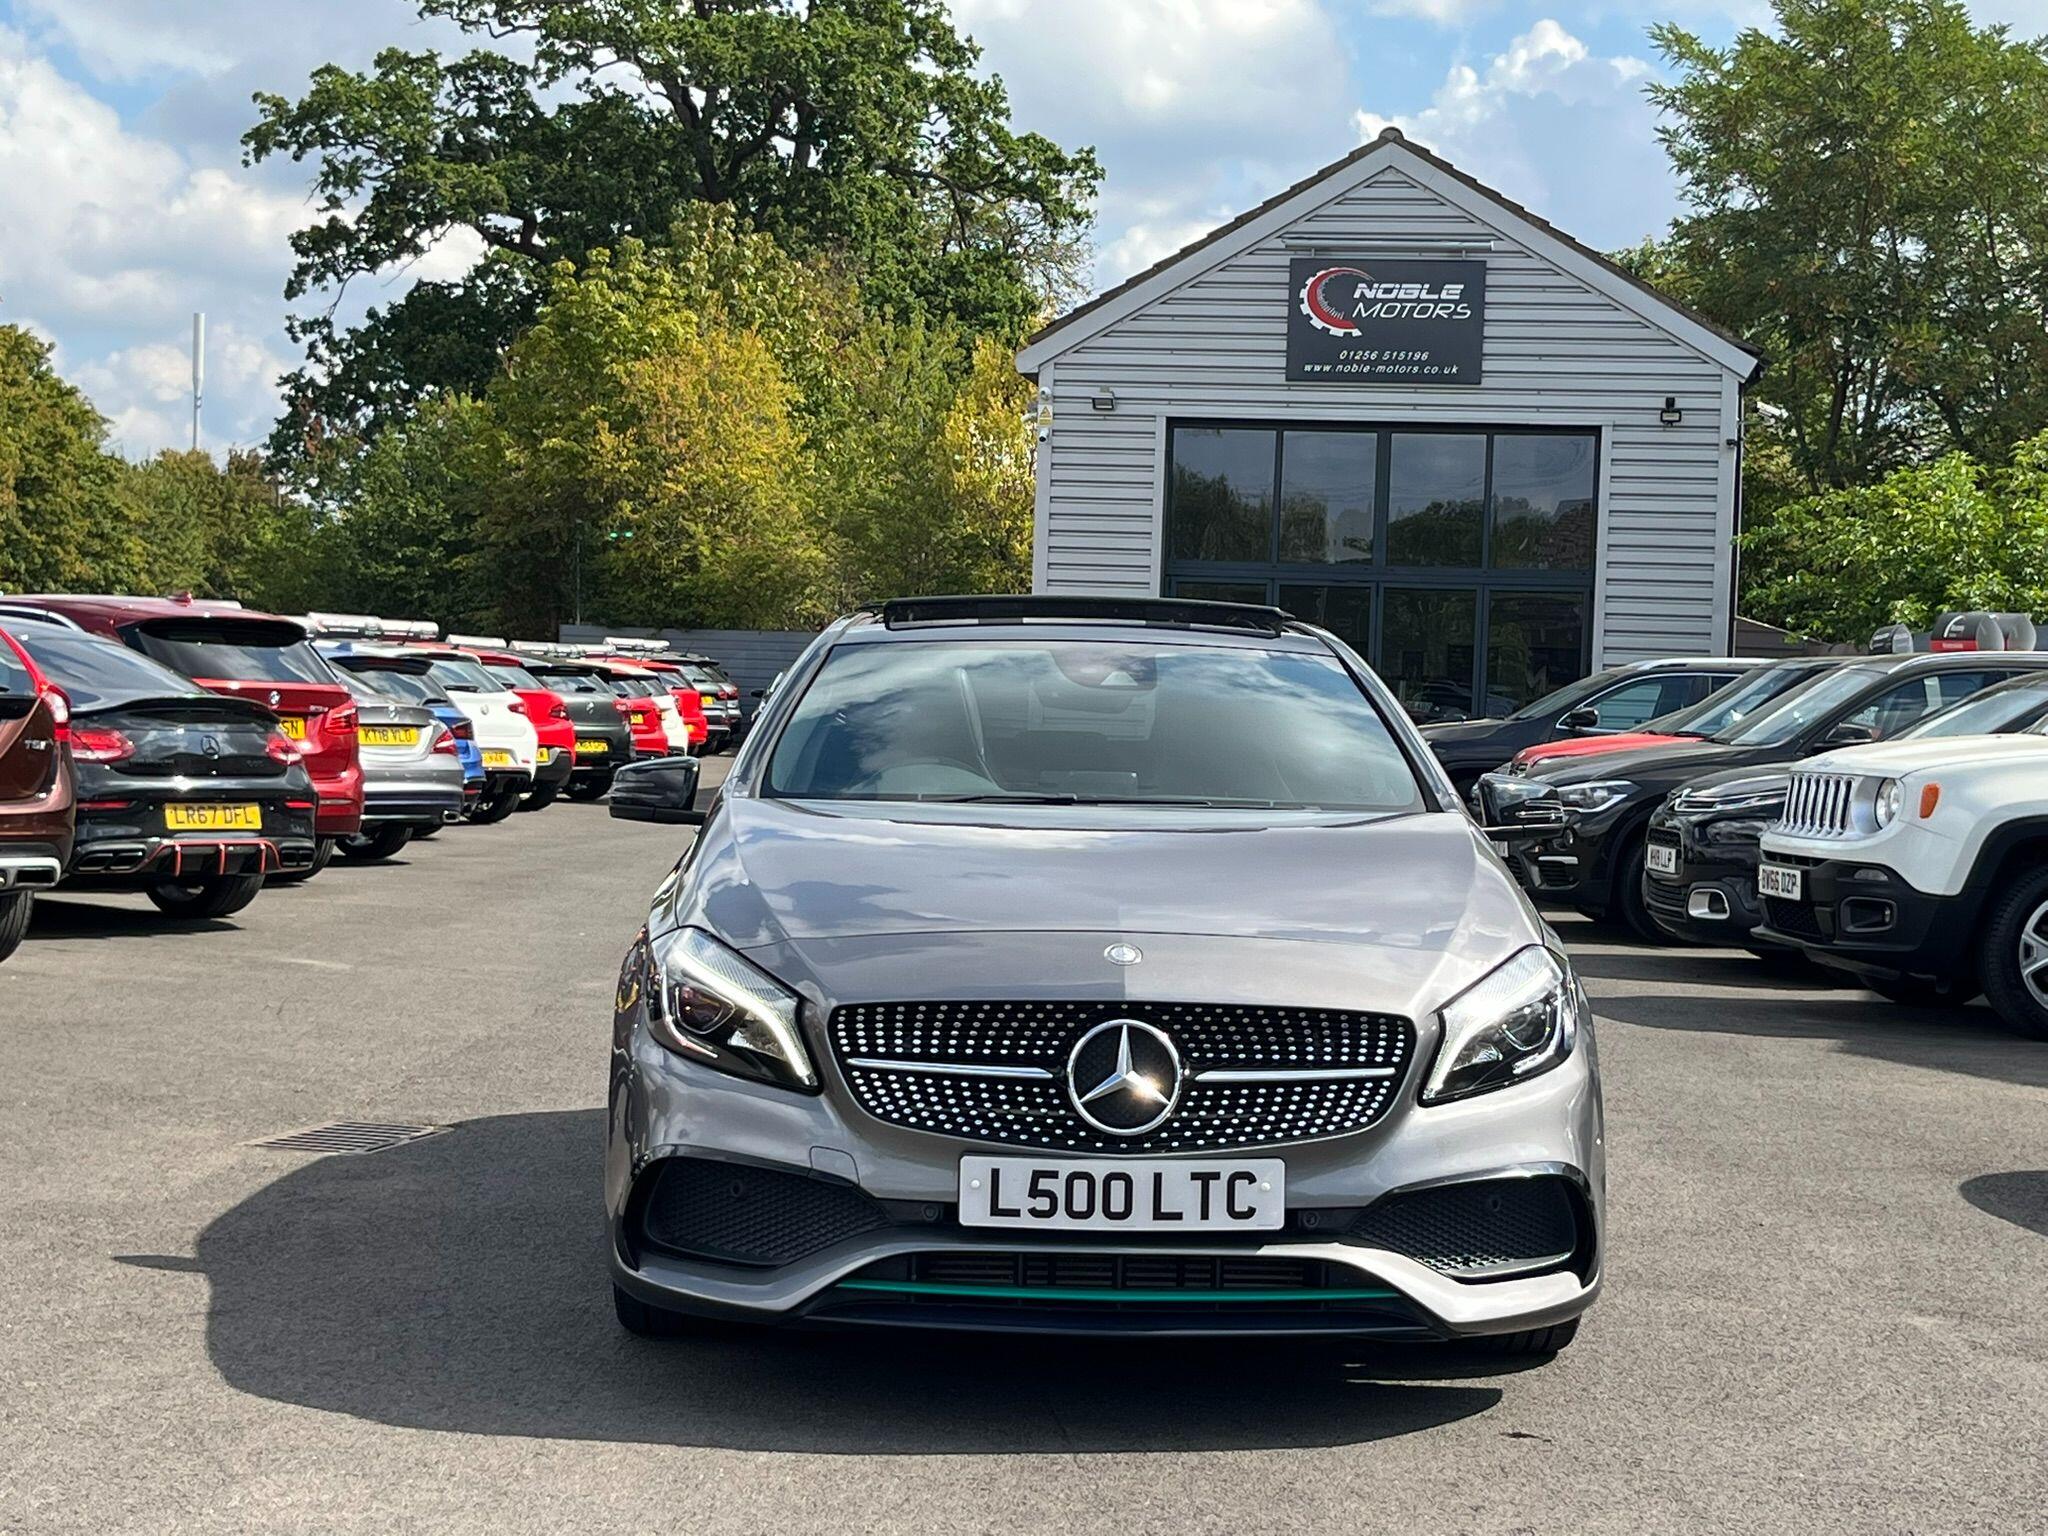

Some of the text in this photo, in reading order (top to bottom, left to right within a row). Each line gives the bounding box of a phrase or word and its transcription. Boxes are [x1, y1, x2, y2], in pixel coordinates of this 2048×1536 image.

[1353, 282, 1465, 300] NOBLE
[1352, 302, 1472, 320] MOTORS
[1339, 350, 1430, 361] 01256 515196
[1303, 363, 1459, 375] www.noble-motors.co.uk
[174, 805, 255, 824] LR67 DFL
[989, 1168, 1258, 1221] L500 LTC
